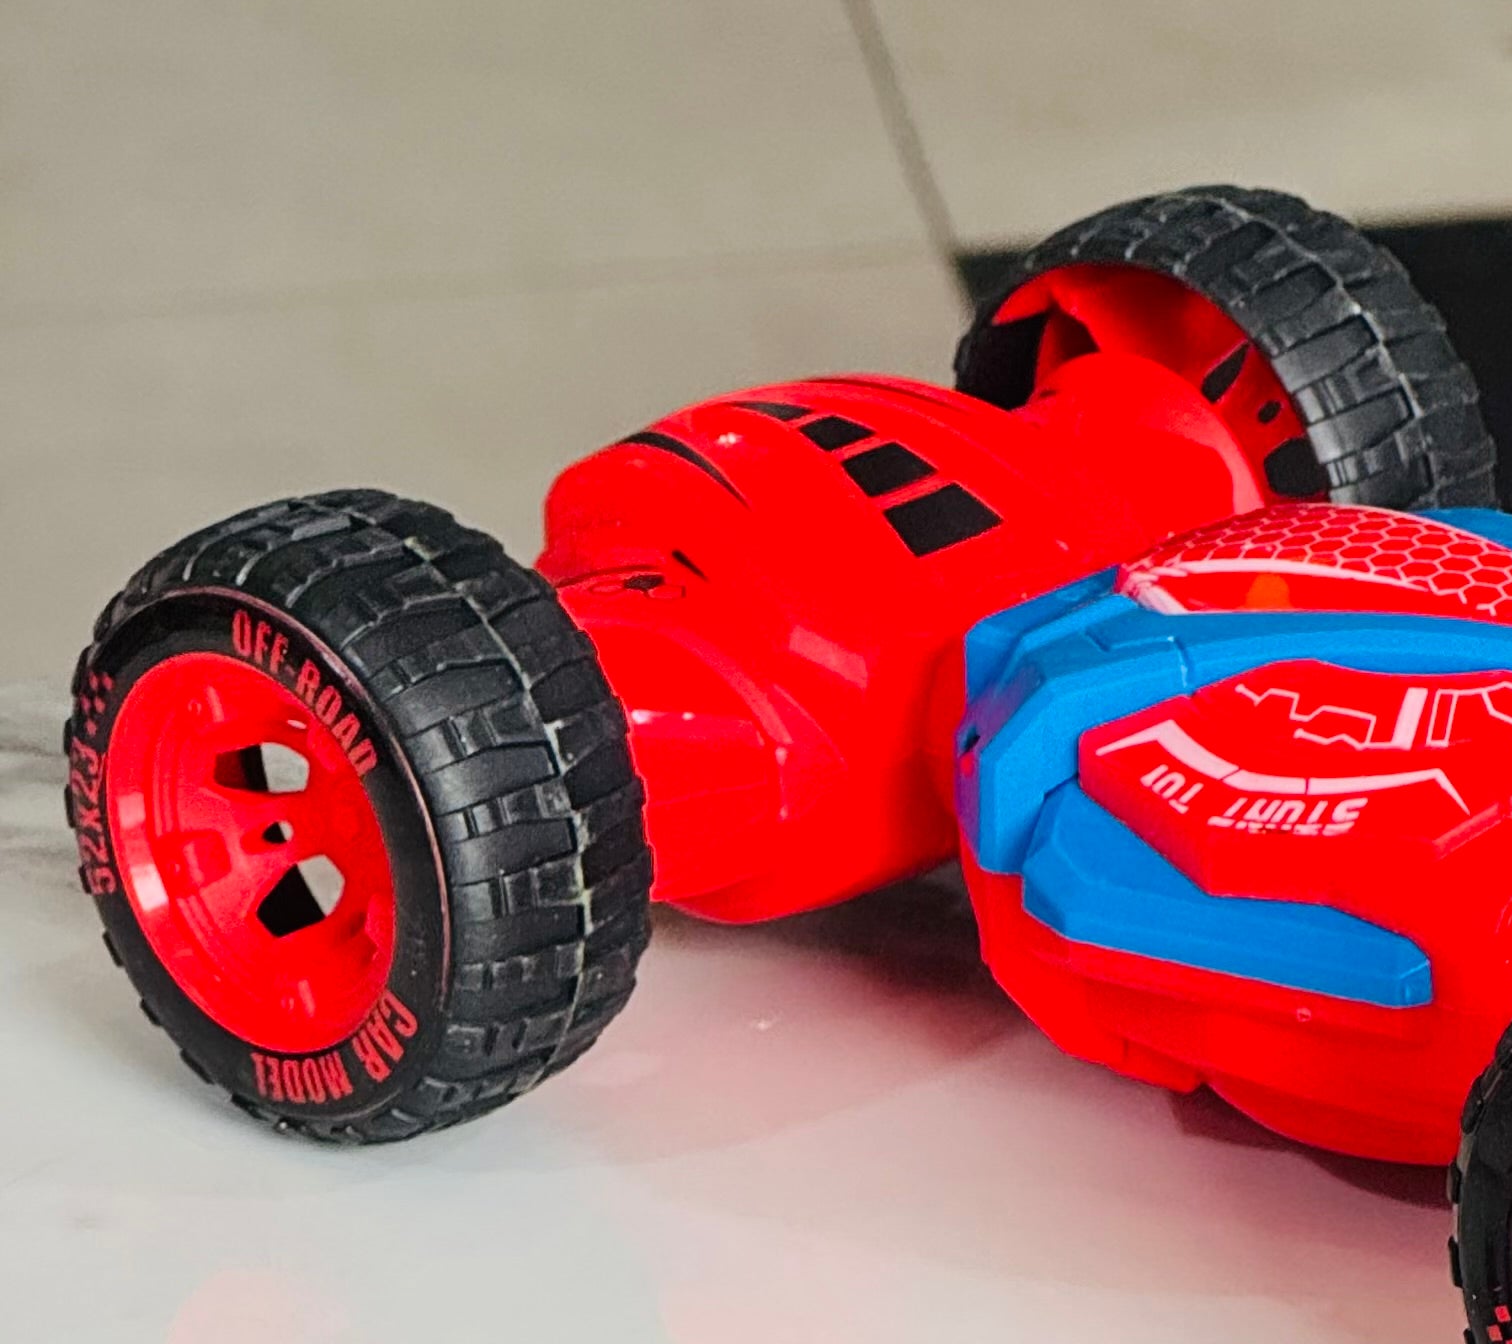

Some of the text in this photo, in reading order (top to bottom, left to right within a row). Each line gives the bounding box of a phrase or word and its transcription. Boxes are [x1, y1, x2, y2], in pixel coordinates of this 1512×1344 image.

[232, 610, 378, 776] OFF-ROAD
[1207, 797, 1368, 836] STUNT
[252, 989, 418, 1104] CAR MODEL
